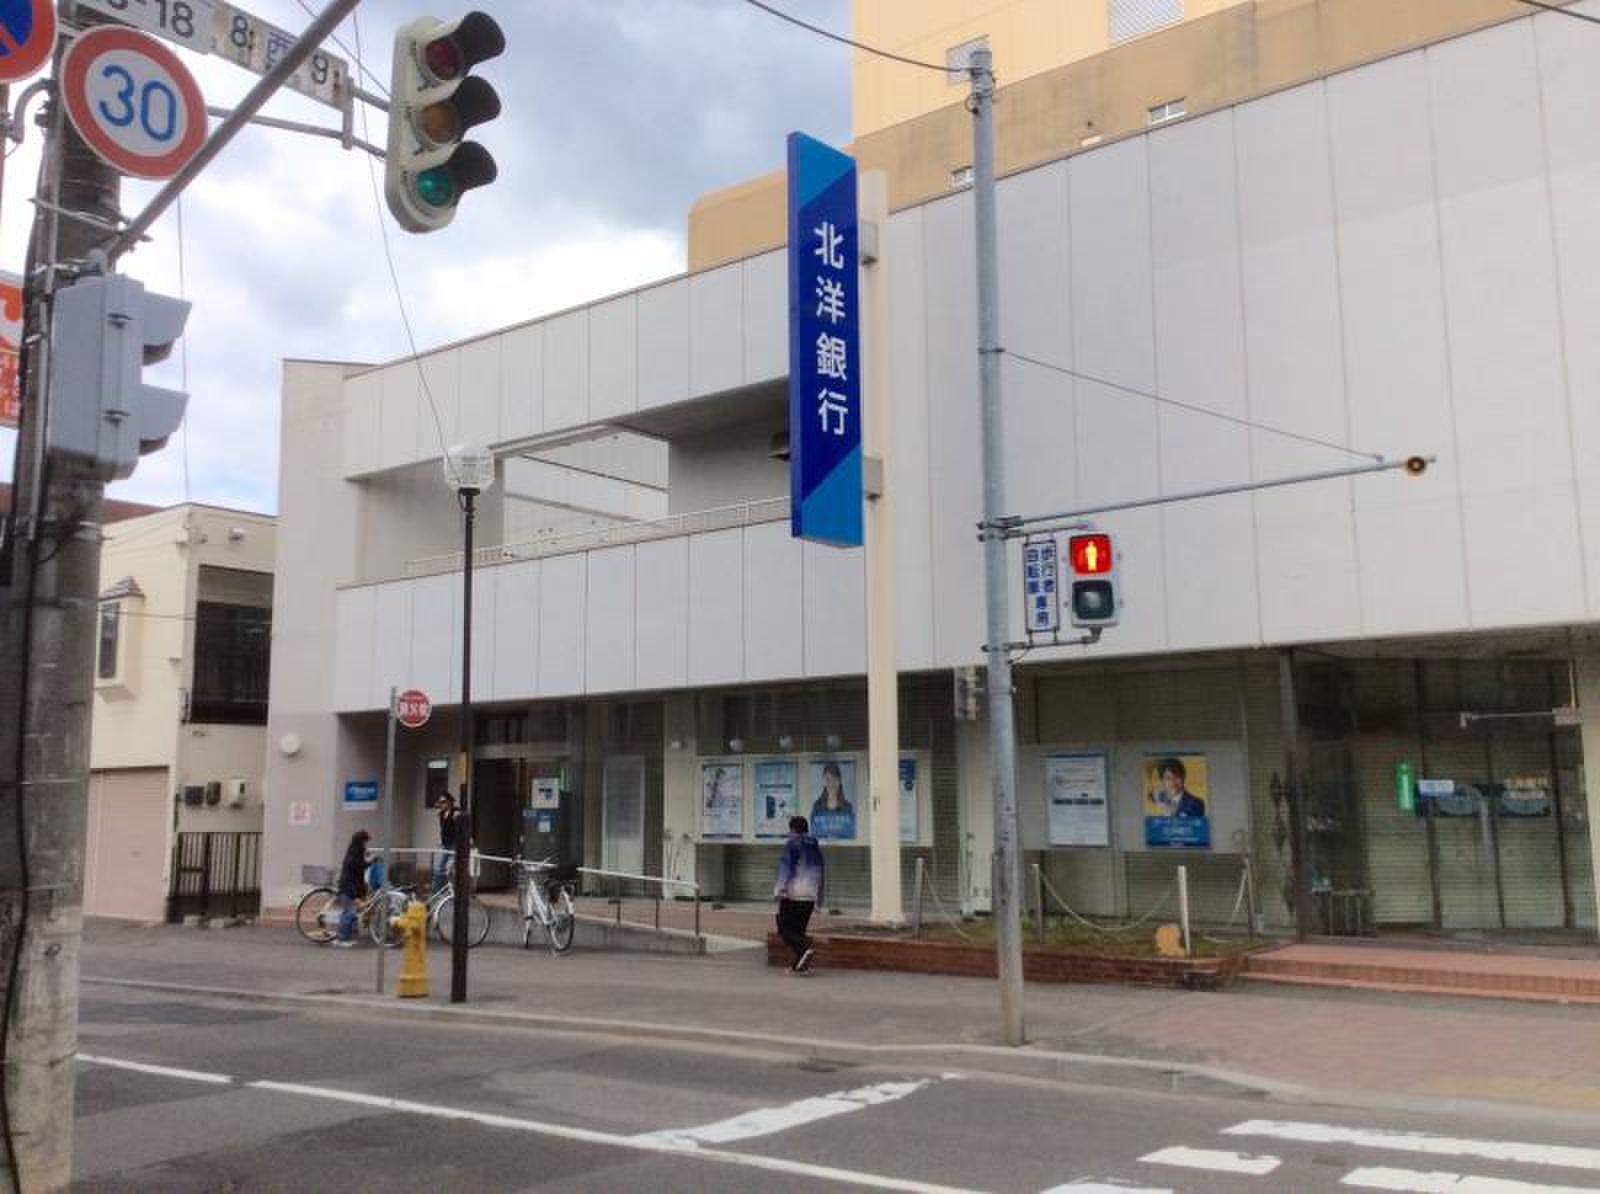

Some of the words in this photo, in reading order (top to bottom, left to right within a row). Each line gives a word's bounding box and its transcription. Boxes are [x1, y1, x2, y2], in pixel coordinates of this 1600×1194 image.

[98, 64, 178, 143] 30
[311, 53, 329, 85] 9
[813, 220, 849, 437] 北洋銀行
